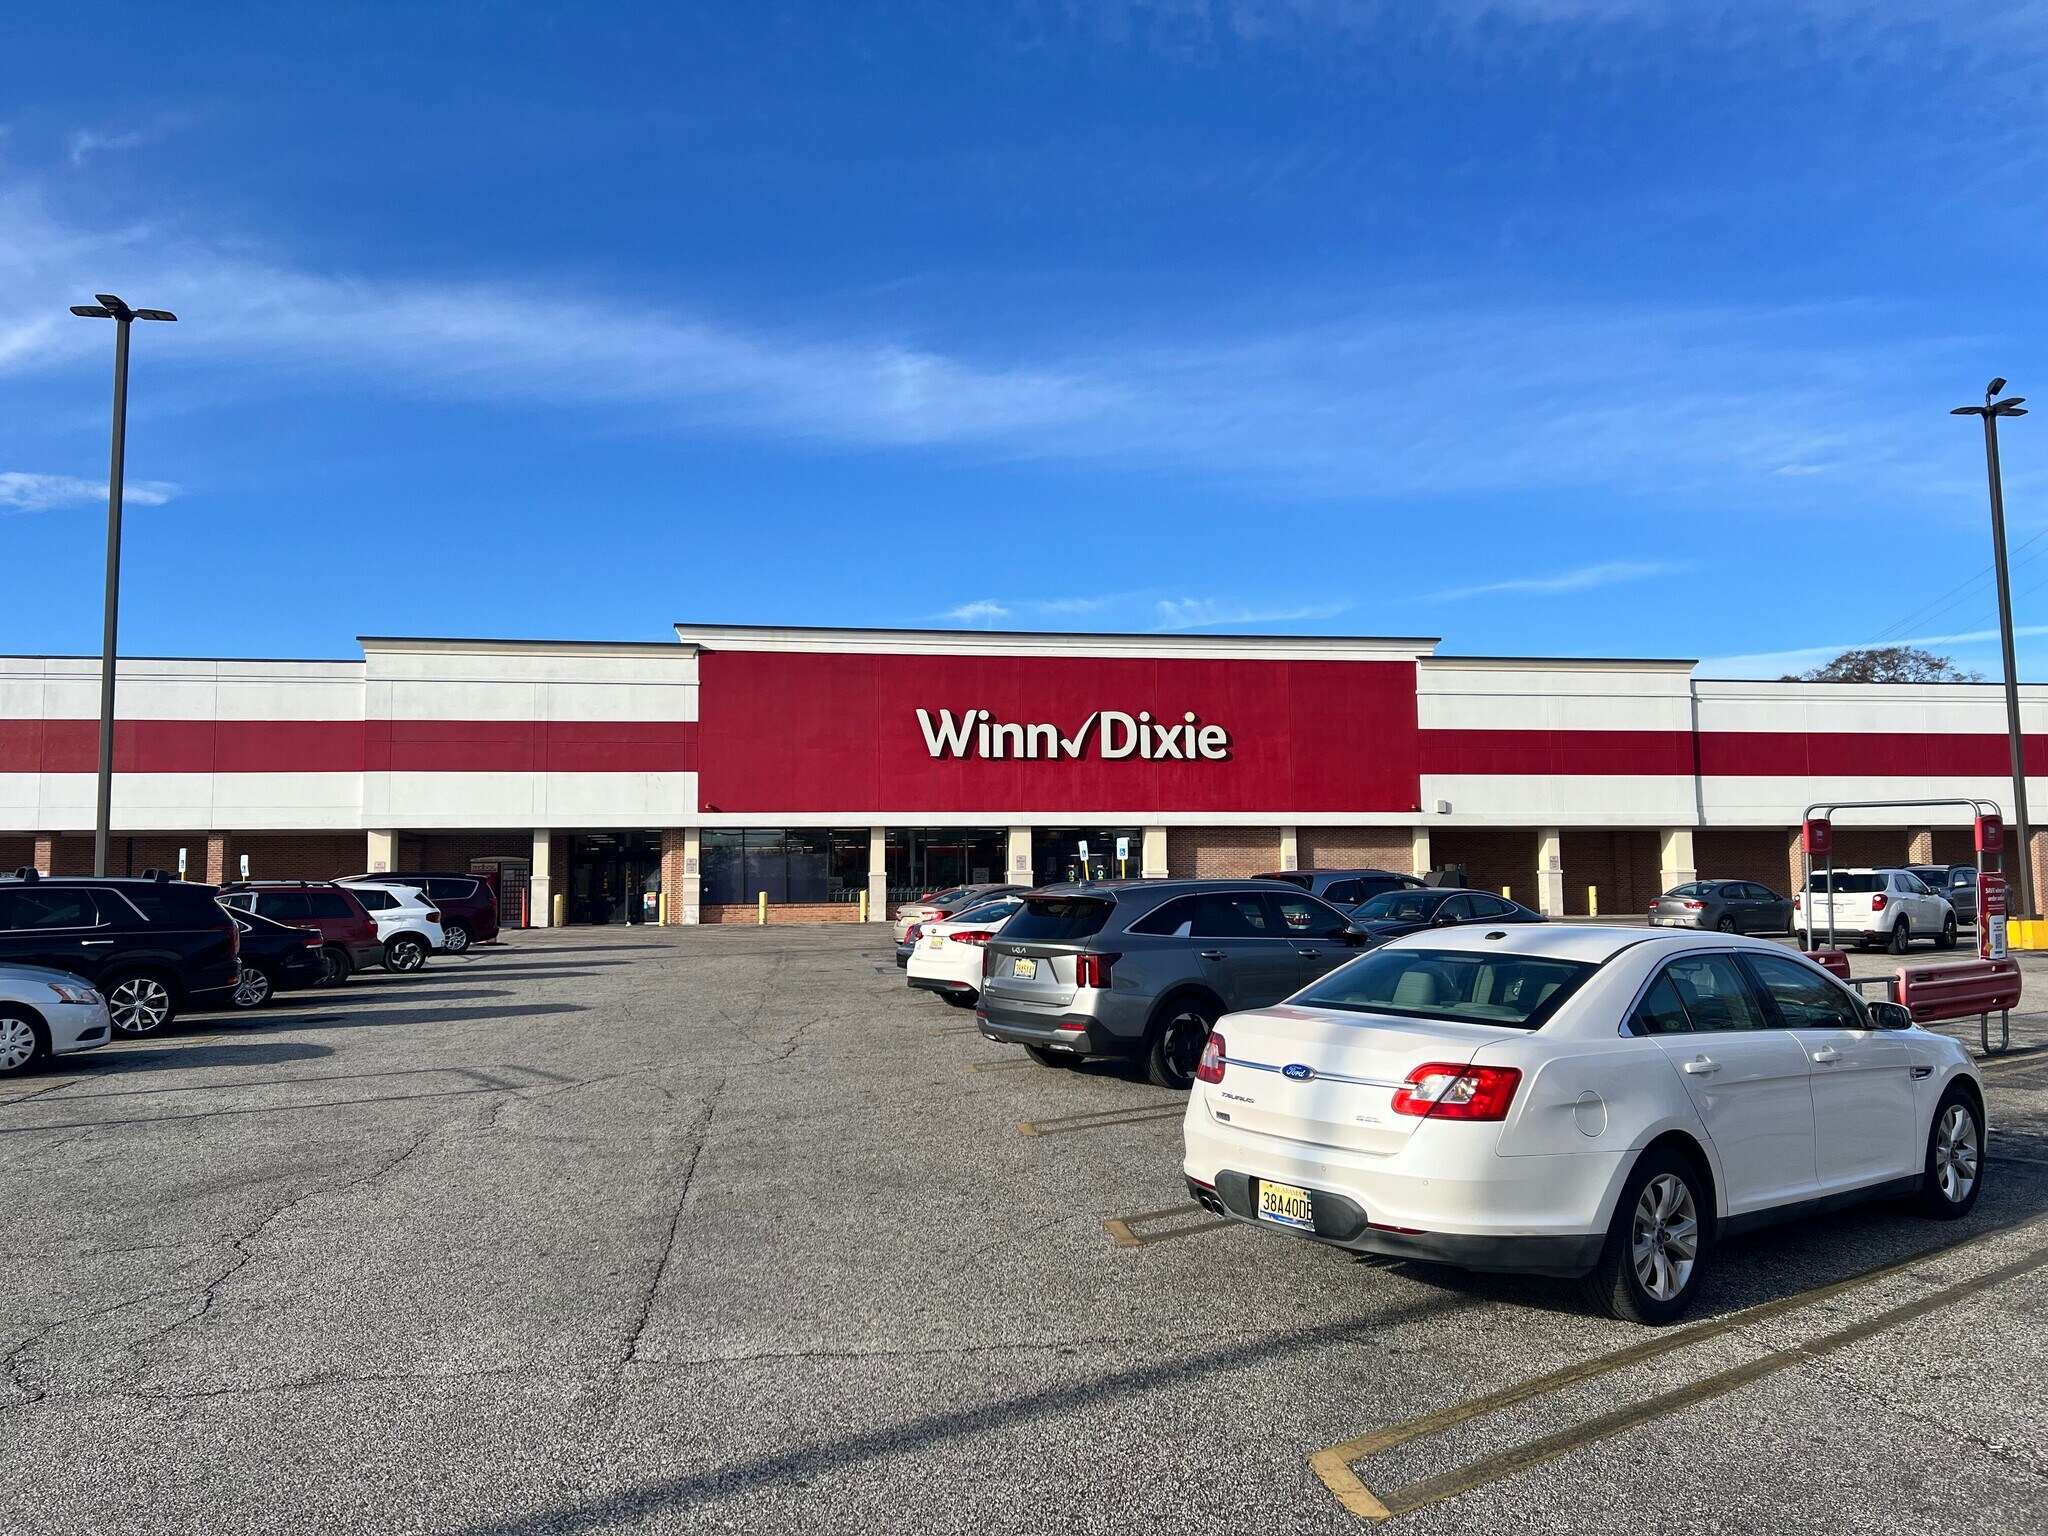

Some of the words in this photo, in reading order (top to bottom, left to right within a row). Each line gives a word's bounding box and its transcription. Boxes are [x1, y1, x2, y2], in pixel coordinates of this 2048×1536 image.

[915, 708, 1058, 758] Winn
[1101, 711, 1227, 759] Dixie
[1285, 1065, 1306, 1078] Ford
[1221, 1092, 1255, 1103] TAURUS
[1263, 1191, 1313, 1220] 38A40DB
